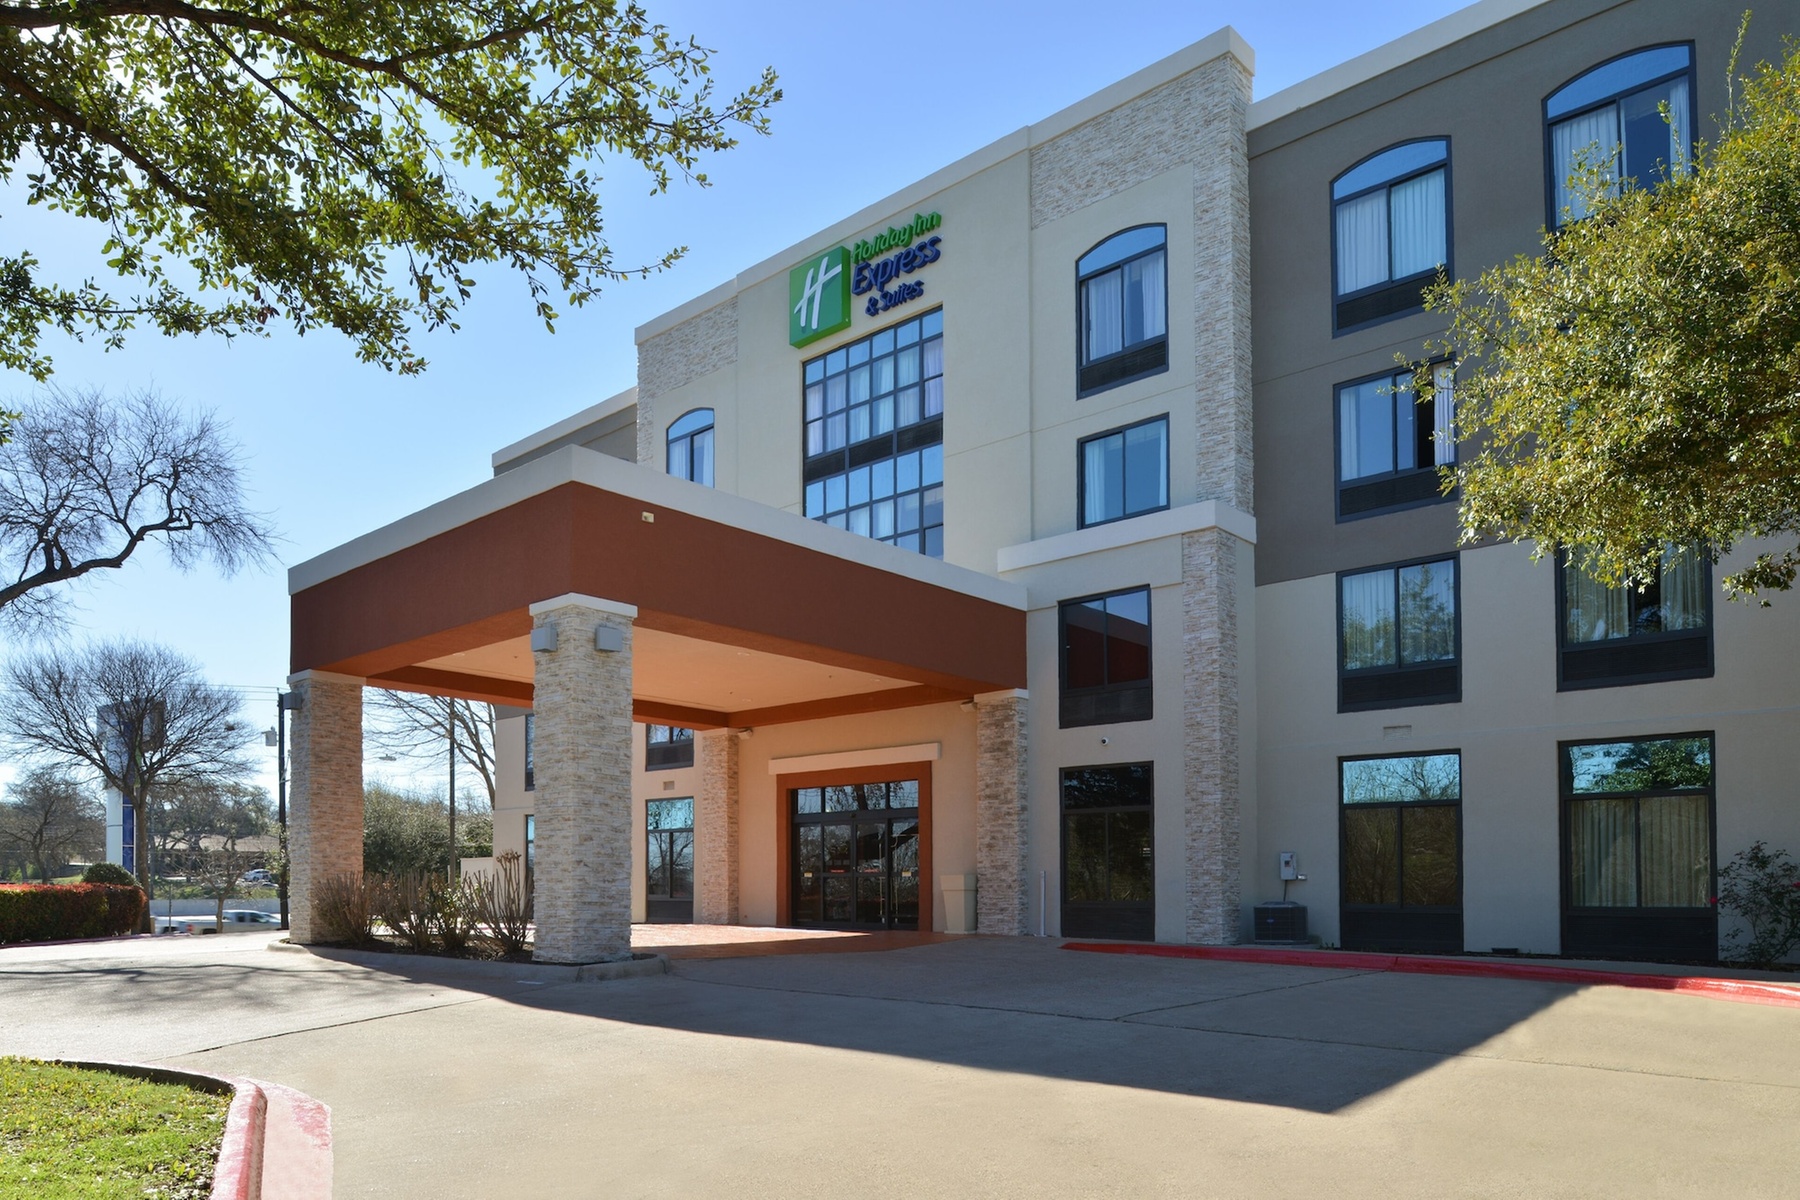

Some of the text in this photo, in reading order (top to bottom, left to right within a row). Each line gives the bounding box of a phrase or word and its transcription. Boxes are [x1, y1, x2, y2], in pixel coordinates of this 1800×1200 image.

[852, 211, 942, 265] Holiday Inn
[851, 235, 942, 296] Express
[865, 280, 925, 317] & Suites
